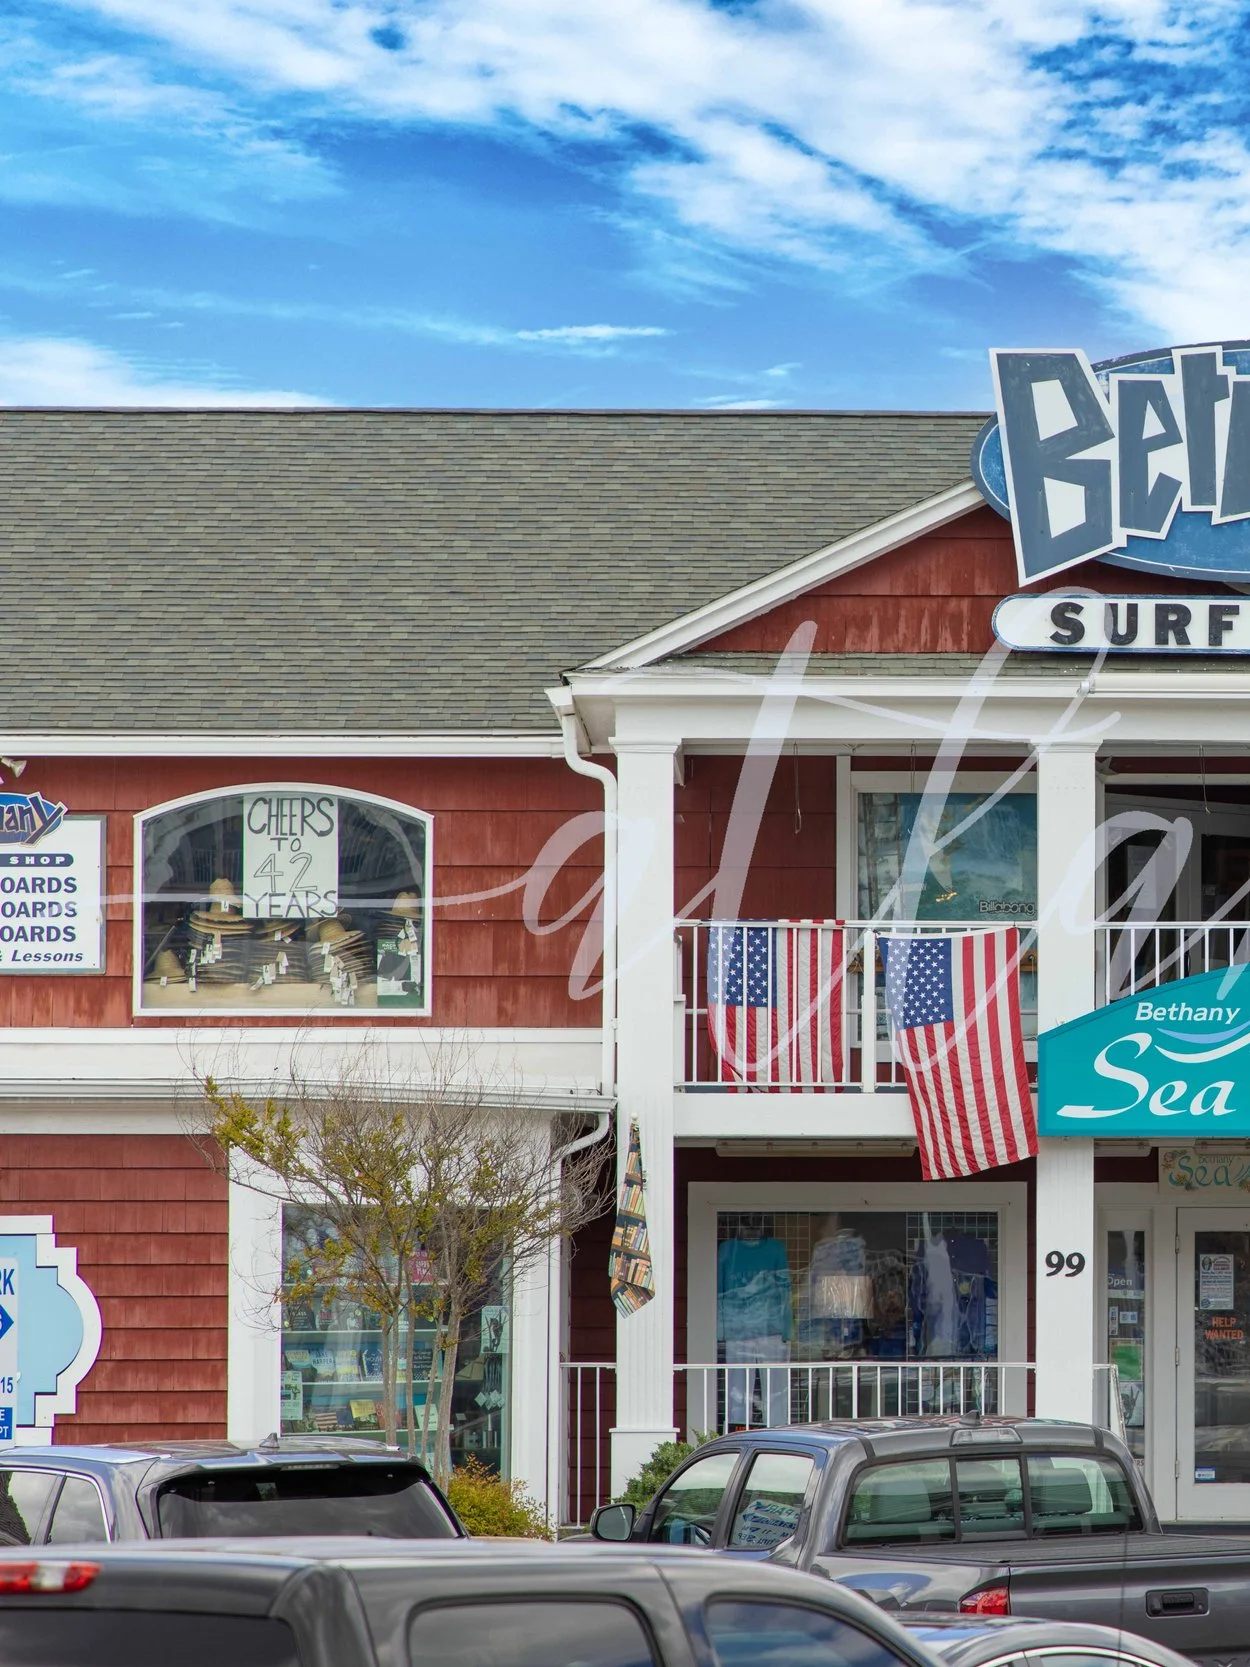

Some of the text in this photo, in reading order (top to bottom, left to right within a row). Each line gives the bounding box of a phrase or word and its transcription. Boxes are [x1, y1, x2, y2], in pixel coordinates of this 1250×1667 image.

[1049, 602, 1240, 647] SURF
[247, 797, 334, 837] CHEERS
[270, 837, 301, 852] TO
[9, 856, 66, 865] SHOP
[254, 852, 318, 893] 42
[244, 890, 337, 918] YEARS
[979, 900, 1035, 916] Billabong
[11, 950, 83, 962] Lessons
[1135, 1002, 1241, 1025] Bethany
[1056, 1033, 1237, 1119] Sea
[1168, 1155, 1232, 1187] Sea
[1045, 1251, 1086, 1277] 99
[1107, 1276, 1133, 1286] Open
[1211, 1316, 1237, 1327] HELP
[1205, 1330, 1244, 1340] WANTED
